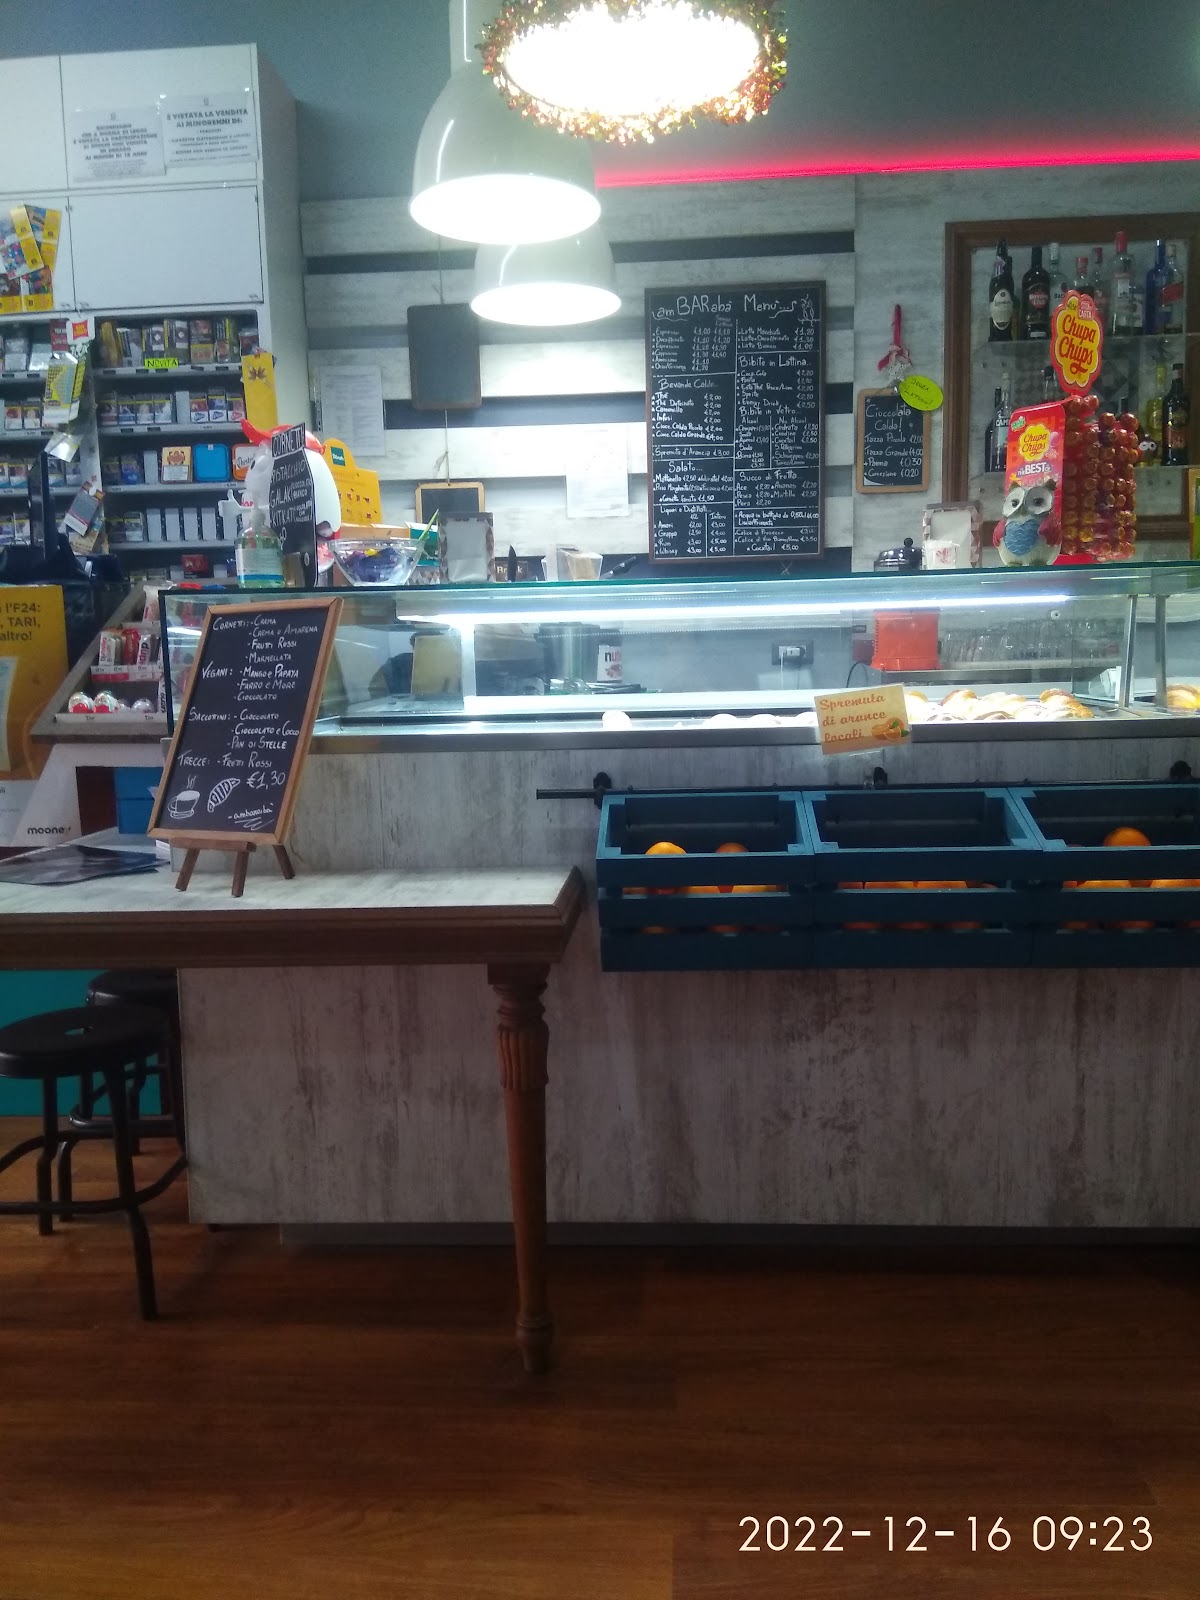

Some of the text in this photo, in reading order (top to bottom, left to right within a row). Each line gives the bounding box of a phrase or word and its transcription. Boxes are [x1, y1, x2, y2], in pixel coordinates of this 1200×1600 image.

[216, 108, 248, 116] VENDITA
[1062, 314, 1096, 345] Chupa
[1059, 336, 1093, 374] Chups
[866, 403, 911, 417] Cioccolata
[865, 432, 883, 442] Tazza
[1024, 434, 1047, 443] Chupa
[885, 446, 908, 456] Grande
[1022, 442, 1045, 454] Chups
[868, 457, 888, 466] Panna
[1025, 462, 1046, 474] BEST
[740, 472, 761, 481] Succo
[658, 530, 677, 538] Grappa
[8, 617, 40, 628] TARI,
[283, 624, 318, 635] AMARENA
[278, 636, 297, 648] ROSSI
[274, 664, 299, 677] PAPAYA
[272, 680, 295, 690] MORE
[820, 693, 885, 711] Spremuta
[822, 711, 886, 726] di arance
[282, 720, 299, 736] COCCO
[824, 729, 864, 743] locali
[258, 736, 287, 750] STELLE
[248, 751, 272, 768] ROSSI
